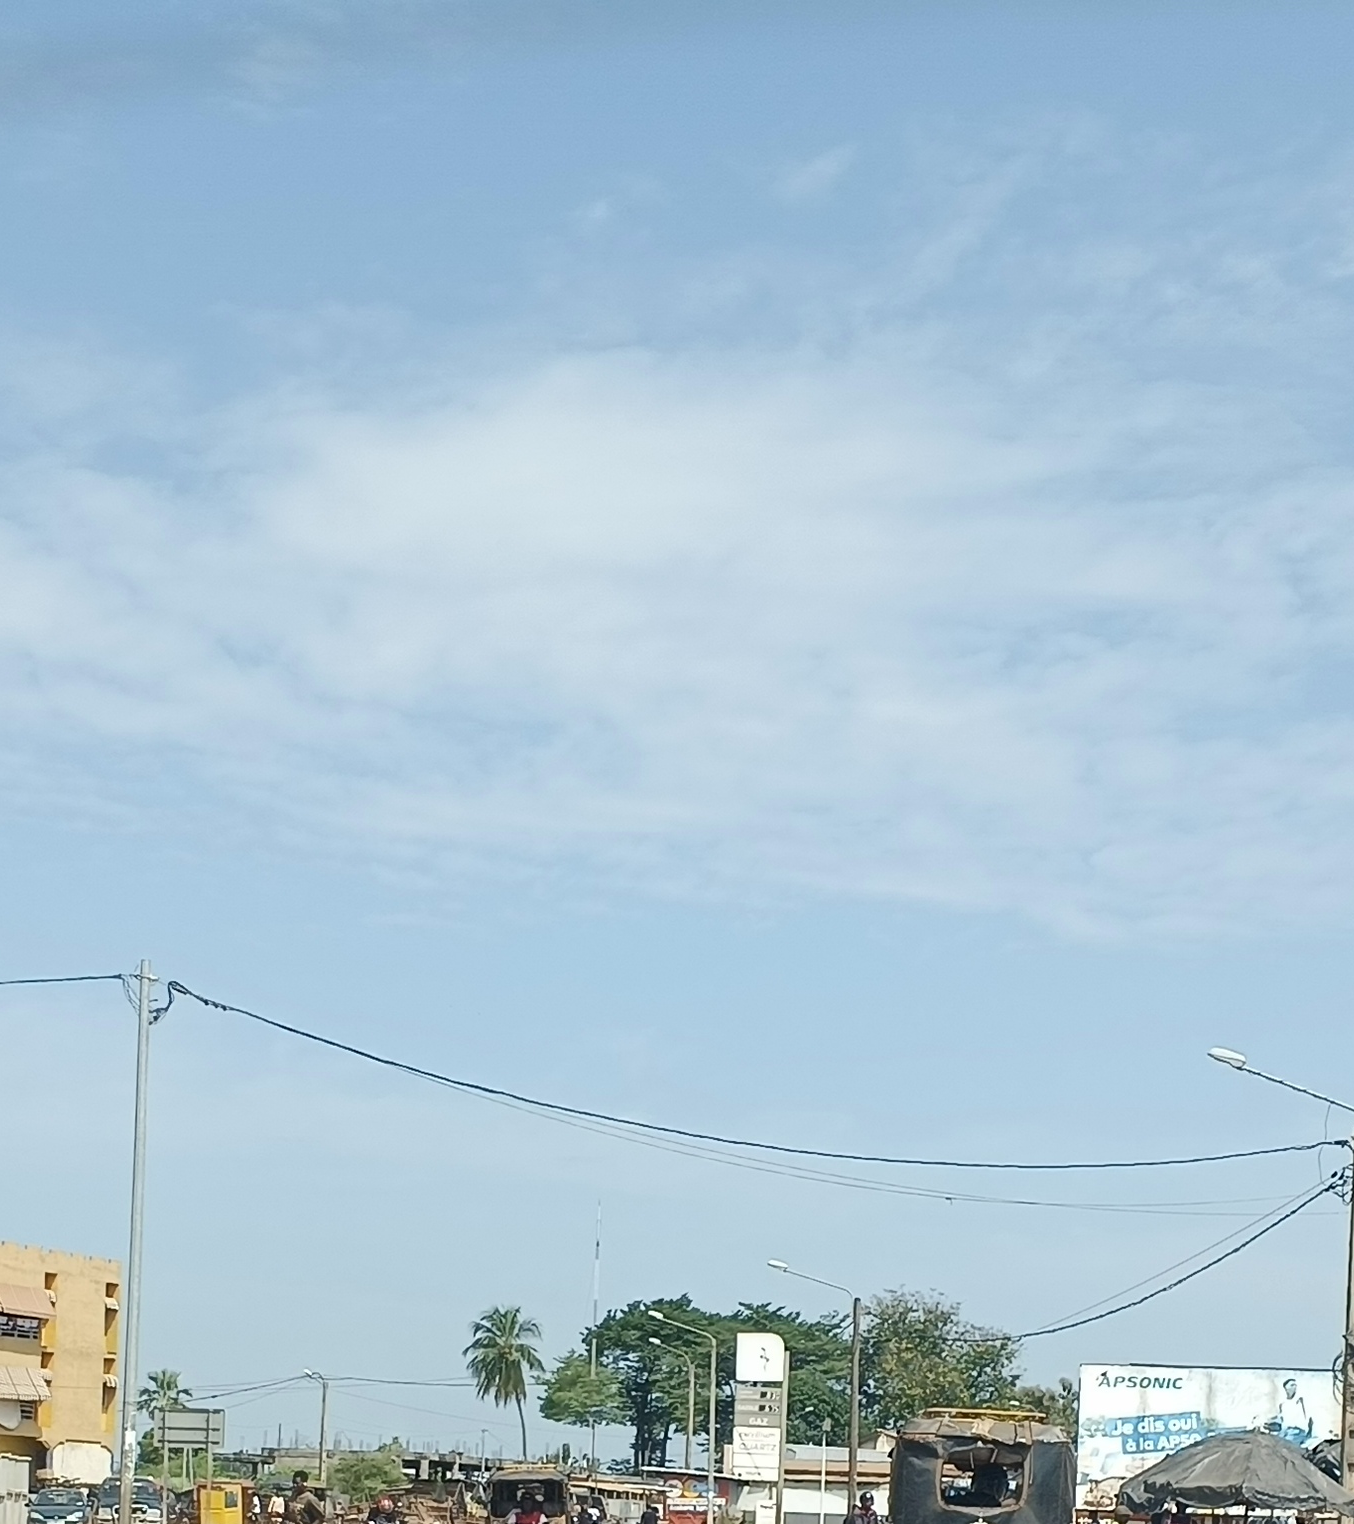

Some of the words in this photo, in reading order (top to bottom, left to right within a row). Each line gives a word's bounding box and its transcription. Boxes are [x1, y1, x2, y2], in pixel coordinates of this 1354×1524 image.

[1098, 1374, 1183, 1390] APSONIC
[1111, 1419, 1134, 1436] Je
[1137, 1416, 1165, 1433] dis
[1167, 1413, 1198, 1432] oui
[739, 1442, 776, 1451] QUARTZ
[1125, 1437, 1137, 1452] à
[1139, 1437, 1154, 1451] la
